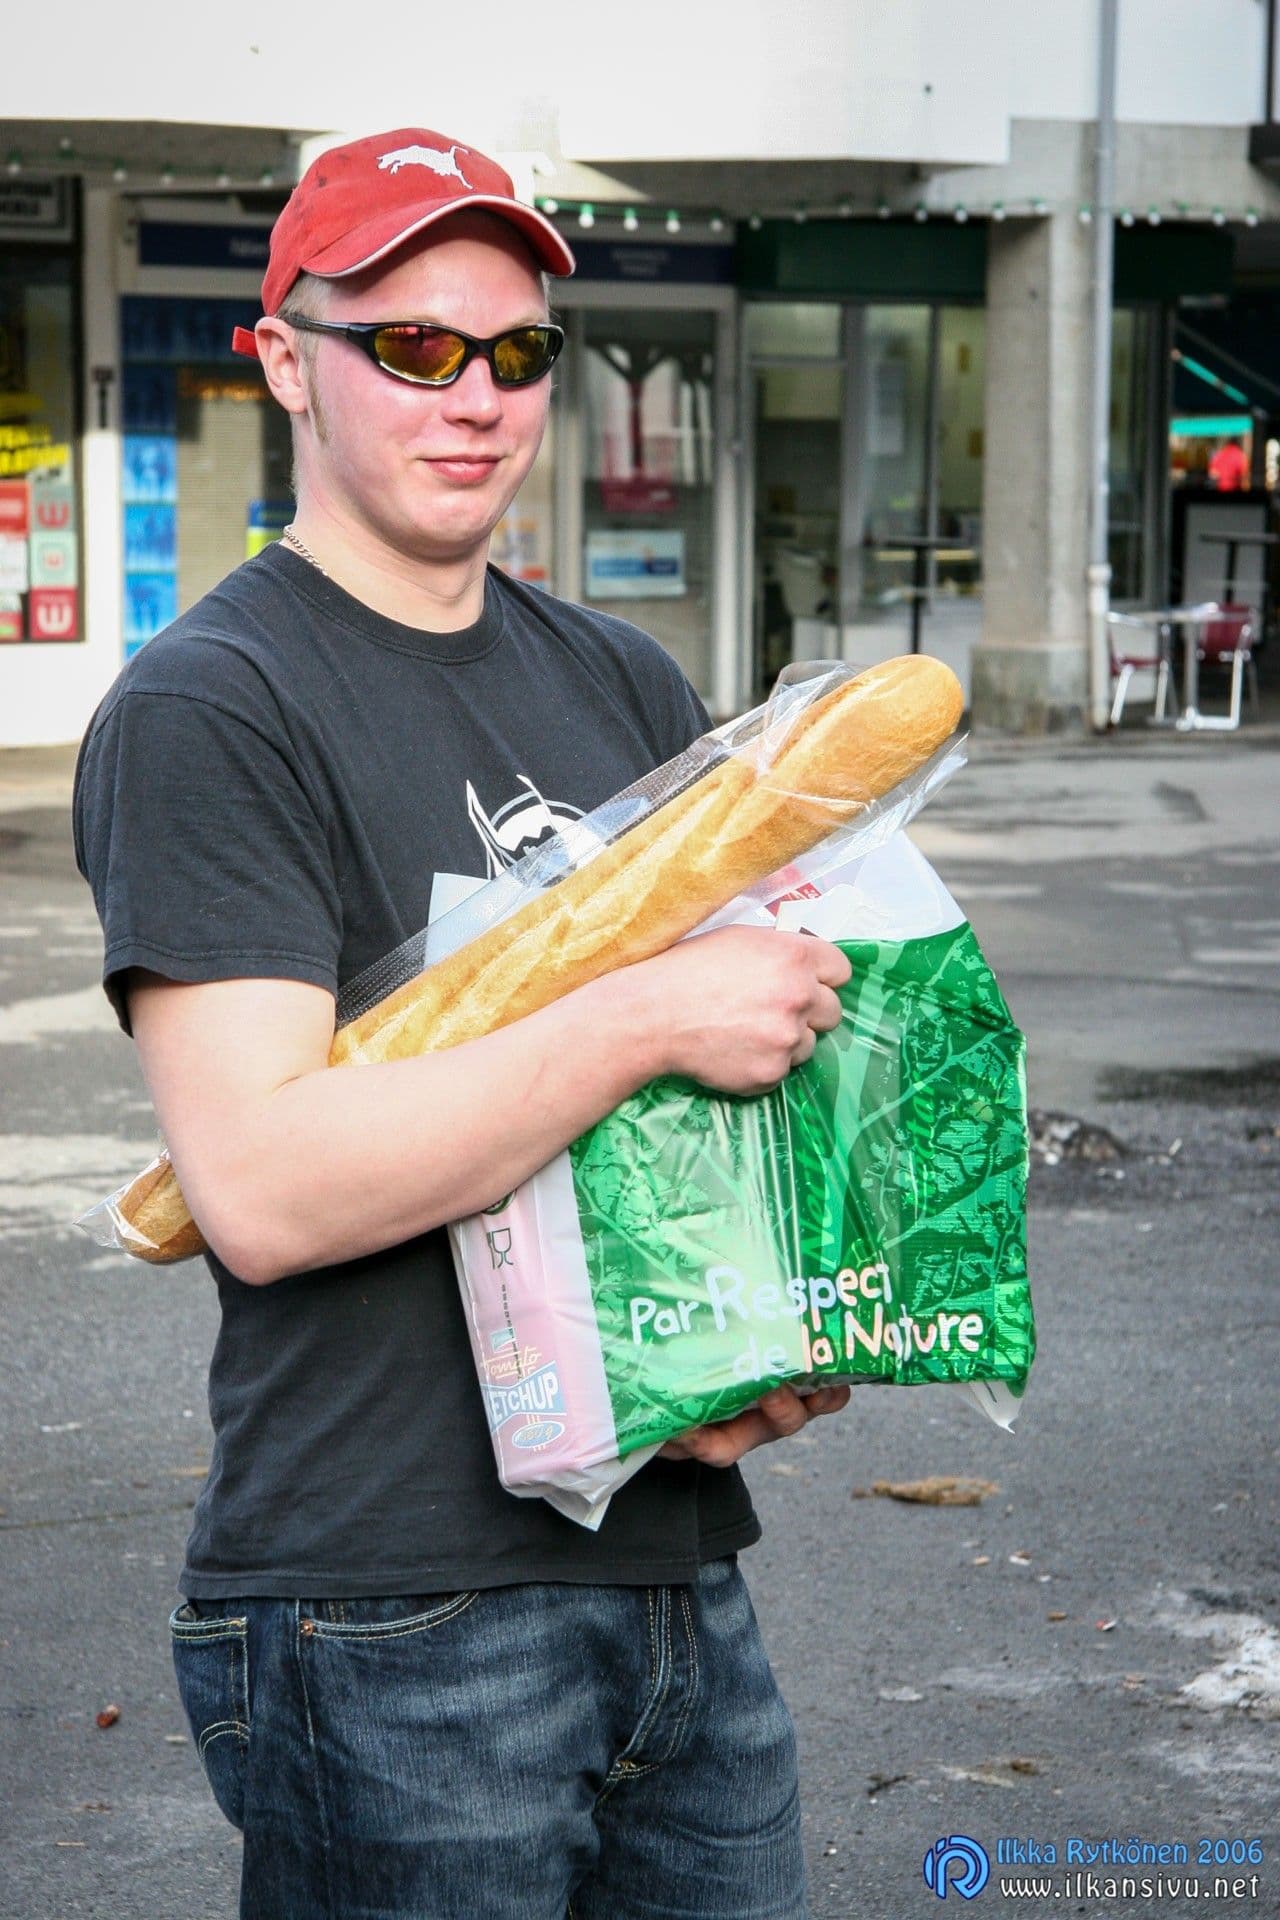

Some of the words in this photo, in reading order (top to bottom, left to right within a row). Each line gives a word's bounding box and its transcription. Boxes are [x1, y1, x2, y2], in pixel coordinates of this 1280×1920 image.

[630, 1297, 699, 1345] Par
[705, 1256, 893, 1332] Respect
[733, 1334, 787, 1381] de
[801, 1323, 834, 1373] la
[844, 1302, 984, 1366] Nature
